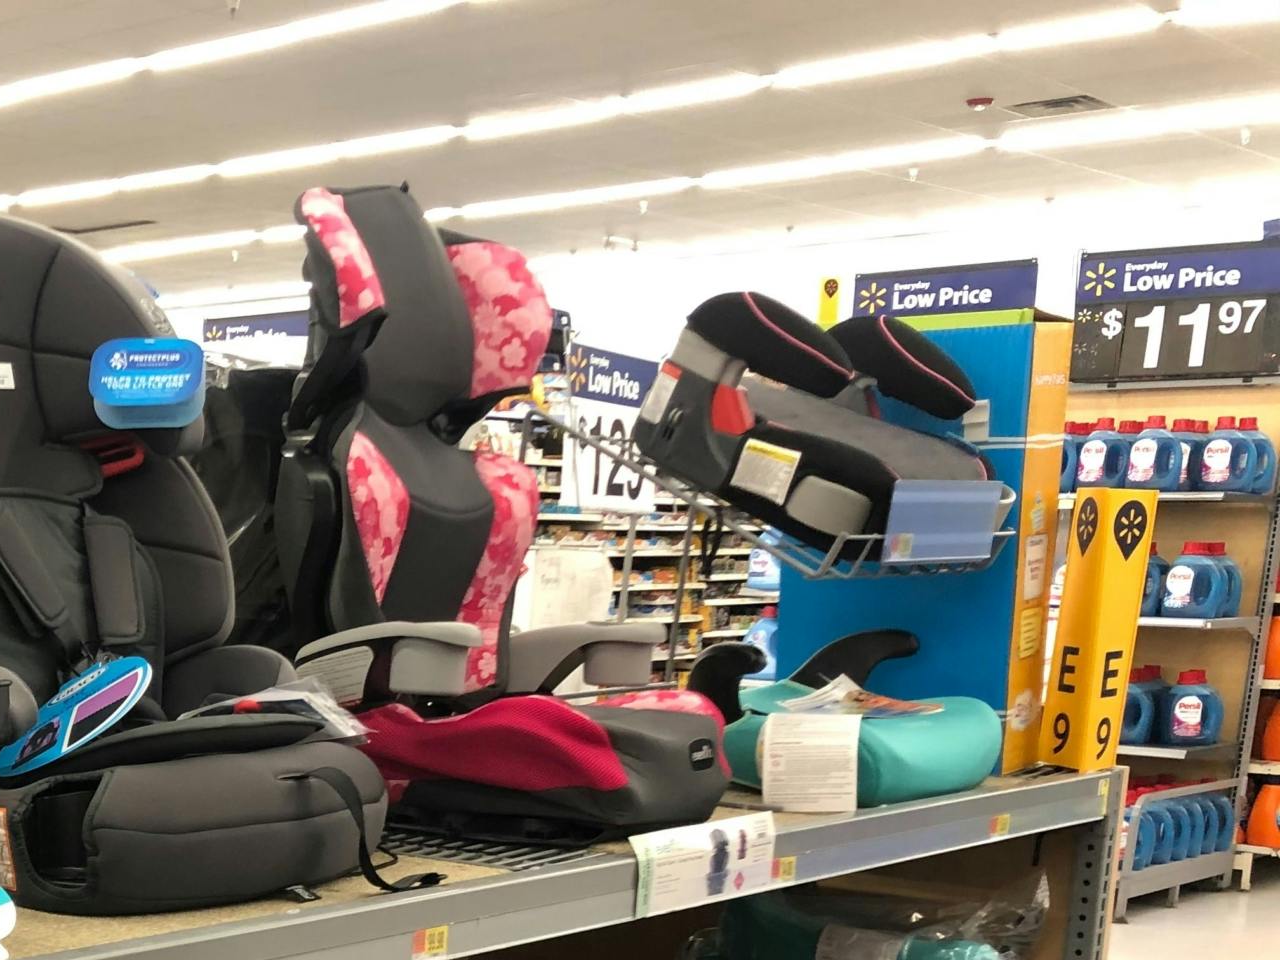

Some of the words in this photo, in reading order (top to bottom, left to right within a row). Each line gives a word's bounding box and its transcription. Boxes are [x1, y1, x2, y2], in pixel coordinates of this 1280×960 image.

[1123, 270, 1181, 294] Low
[1183, 265, 1242, 290] Price
[1125, 260, 1169, 272] Everyday
[892, 292, 937, 311] Low
[939, 284, 993, 307] Price
[894, 281, 931, 291] Everyday
[1217, 299, 1268, 335] 97
[588, 366, 612, 396] Low
[612, 370, 641, 401] Price
[1057, 646, 1080, 693] E
[1100, 650, 1123, 698] E
[1178, 702, 1202, 711] Persil
[1053, 713, 1070, 755] 9
[1096, 717, 1111, 760] 9
